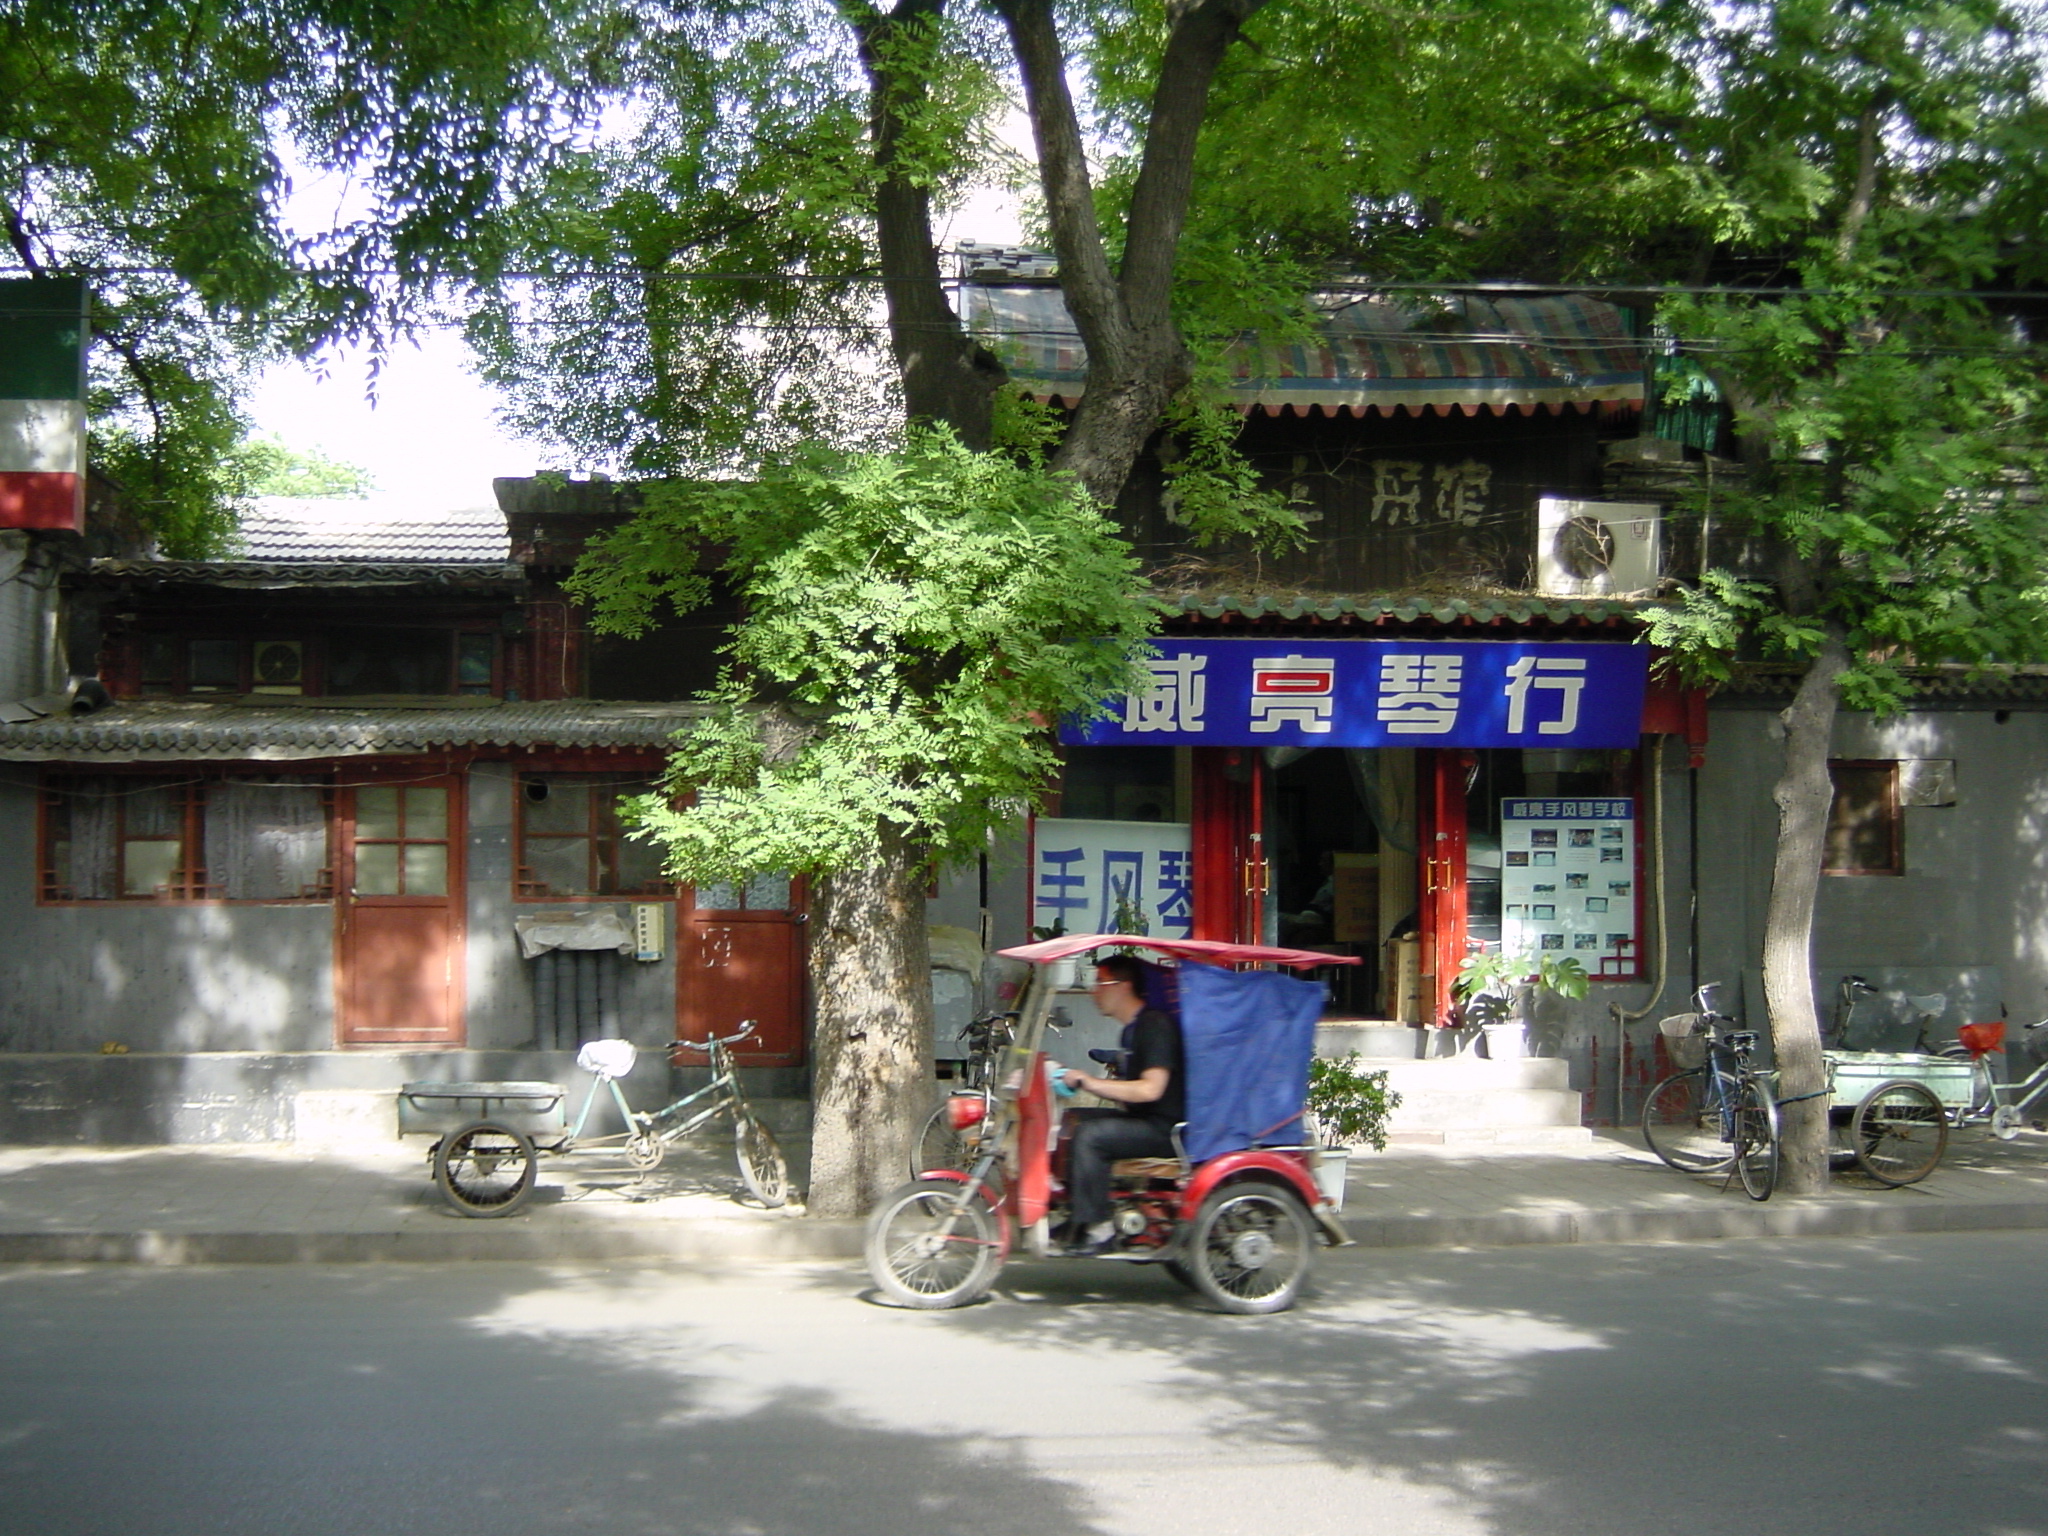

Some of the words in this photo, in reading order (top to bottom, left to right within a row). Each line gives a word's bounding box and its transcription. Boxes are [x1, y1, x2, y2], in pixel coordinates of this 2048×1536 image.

[1123, 653, 1587, 735] 威亮琴行
[1512, 802, 1627, 817] 威亮手风琴学校
